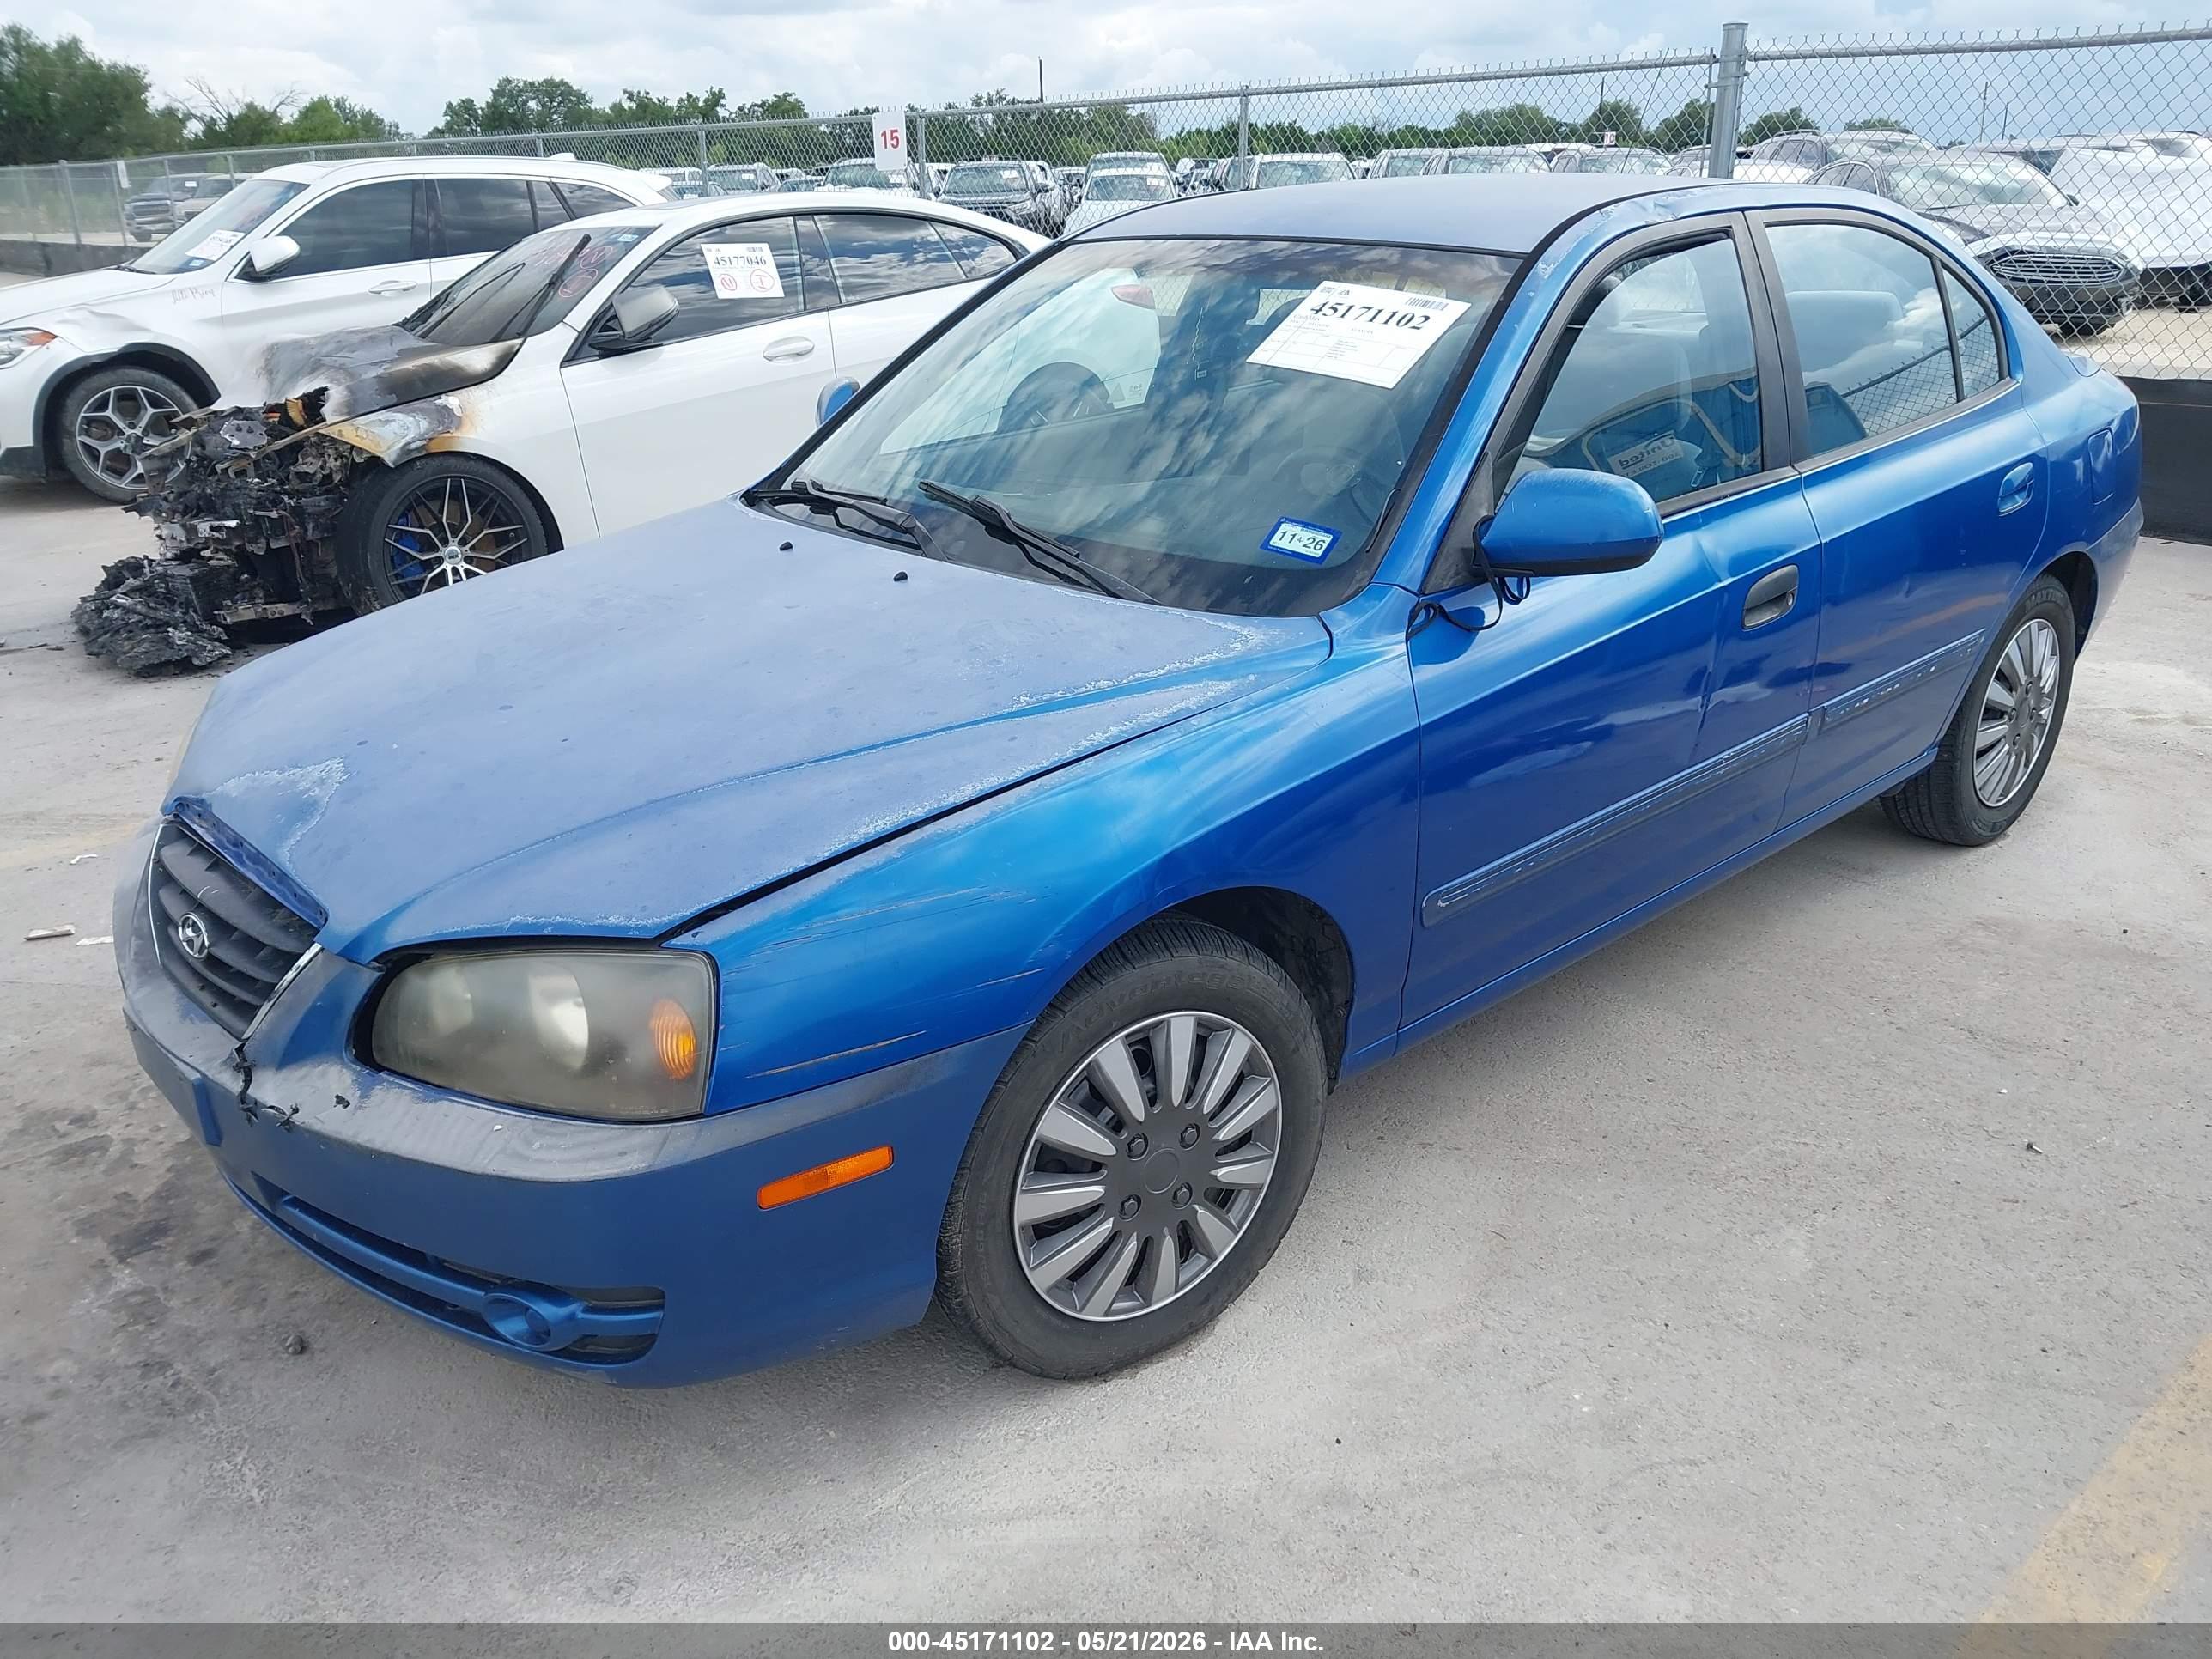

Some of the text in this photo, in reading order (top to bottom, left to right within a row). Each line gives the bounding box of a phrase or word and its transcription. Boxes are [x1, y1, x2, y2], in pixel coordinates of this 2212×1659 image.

[880, 129, 900, 149] 15
[714, 256, 767, 266] 45177046
[1310, 301, 1431, 331] 45171102
